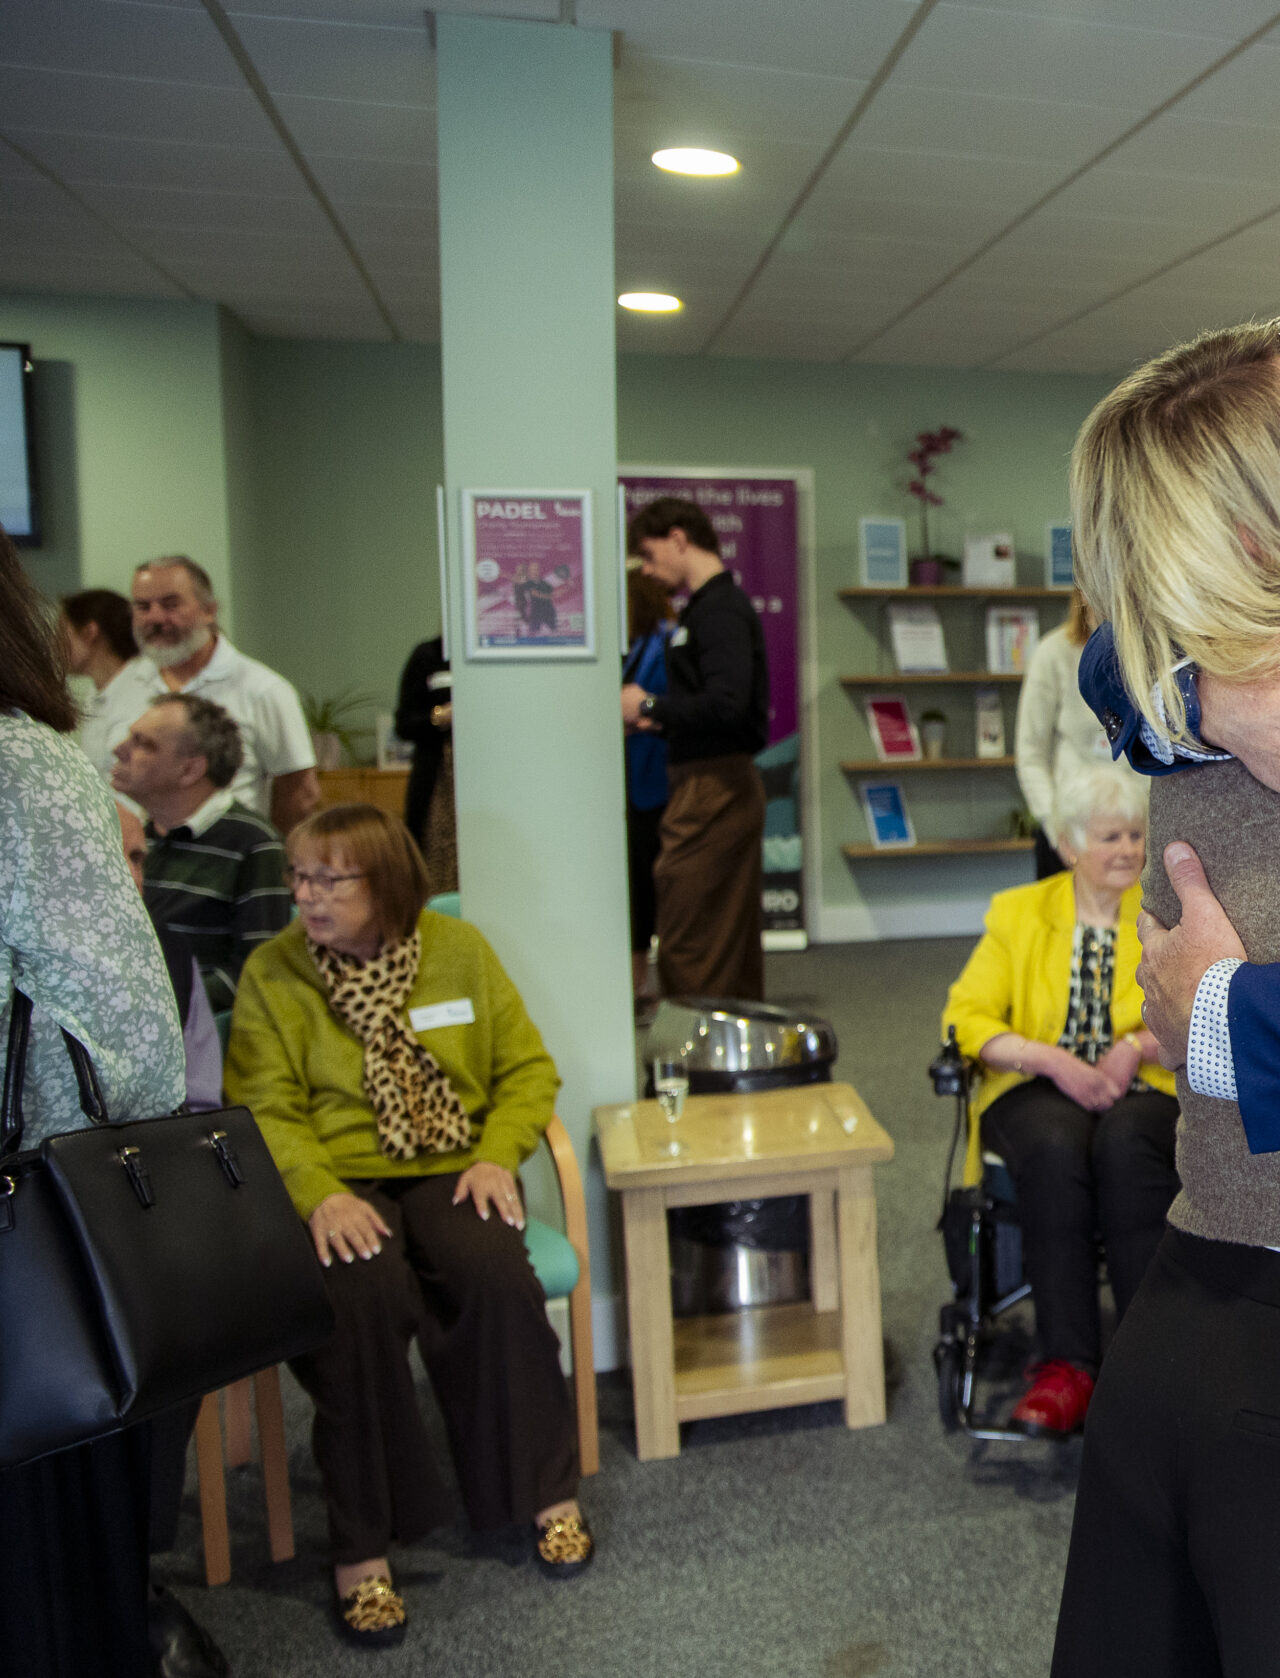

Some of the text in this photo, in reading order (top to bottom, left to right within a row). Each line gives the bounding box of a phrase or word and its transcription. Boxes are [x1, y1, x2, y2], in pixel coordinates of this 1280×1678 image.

[696, 487, 732, 506] the
[735, 487, 784, 507] lives
[477, 502, 547, 519] PADEL
